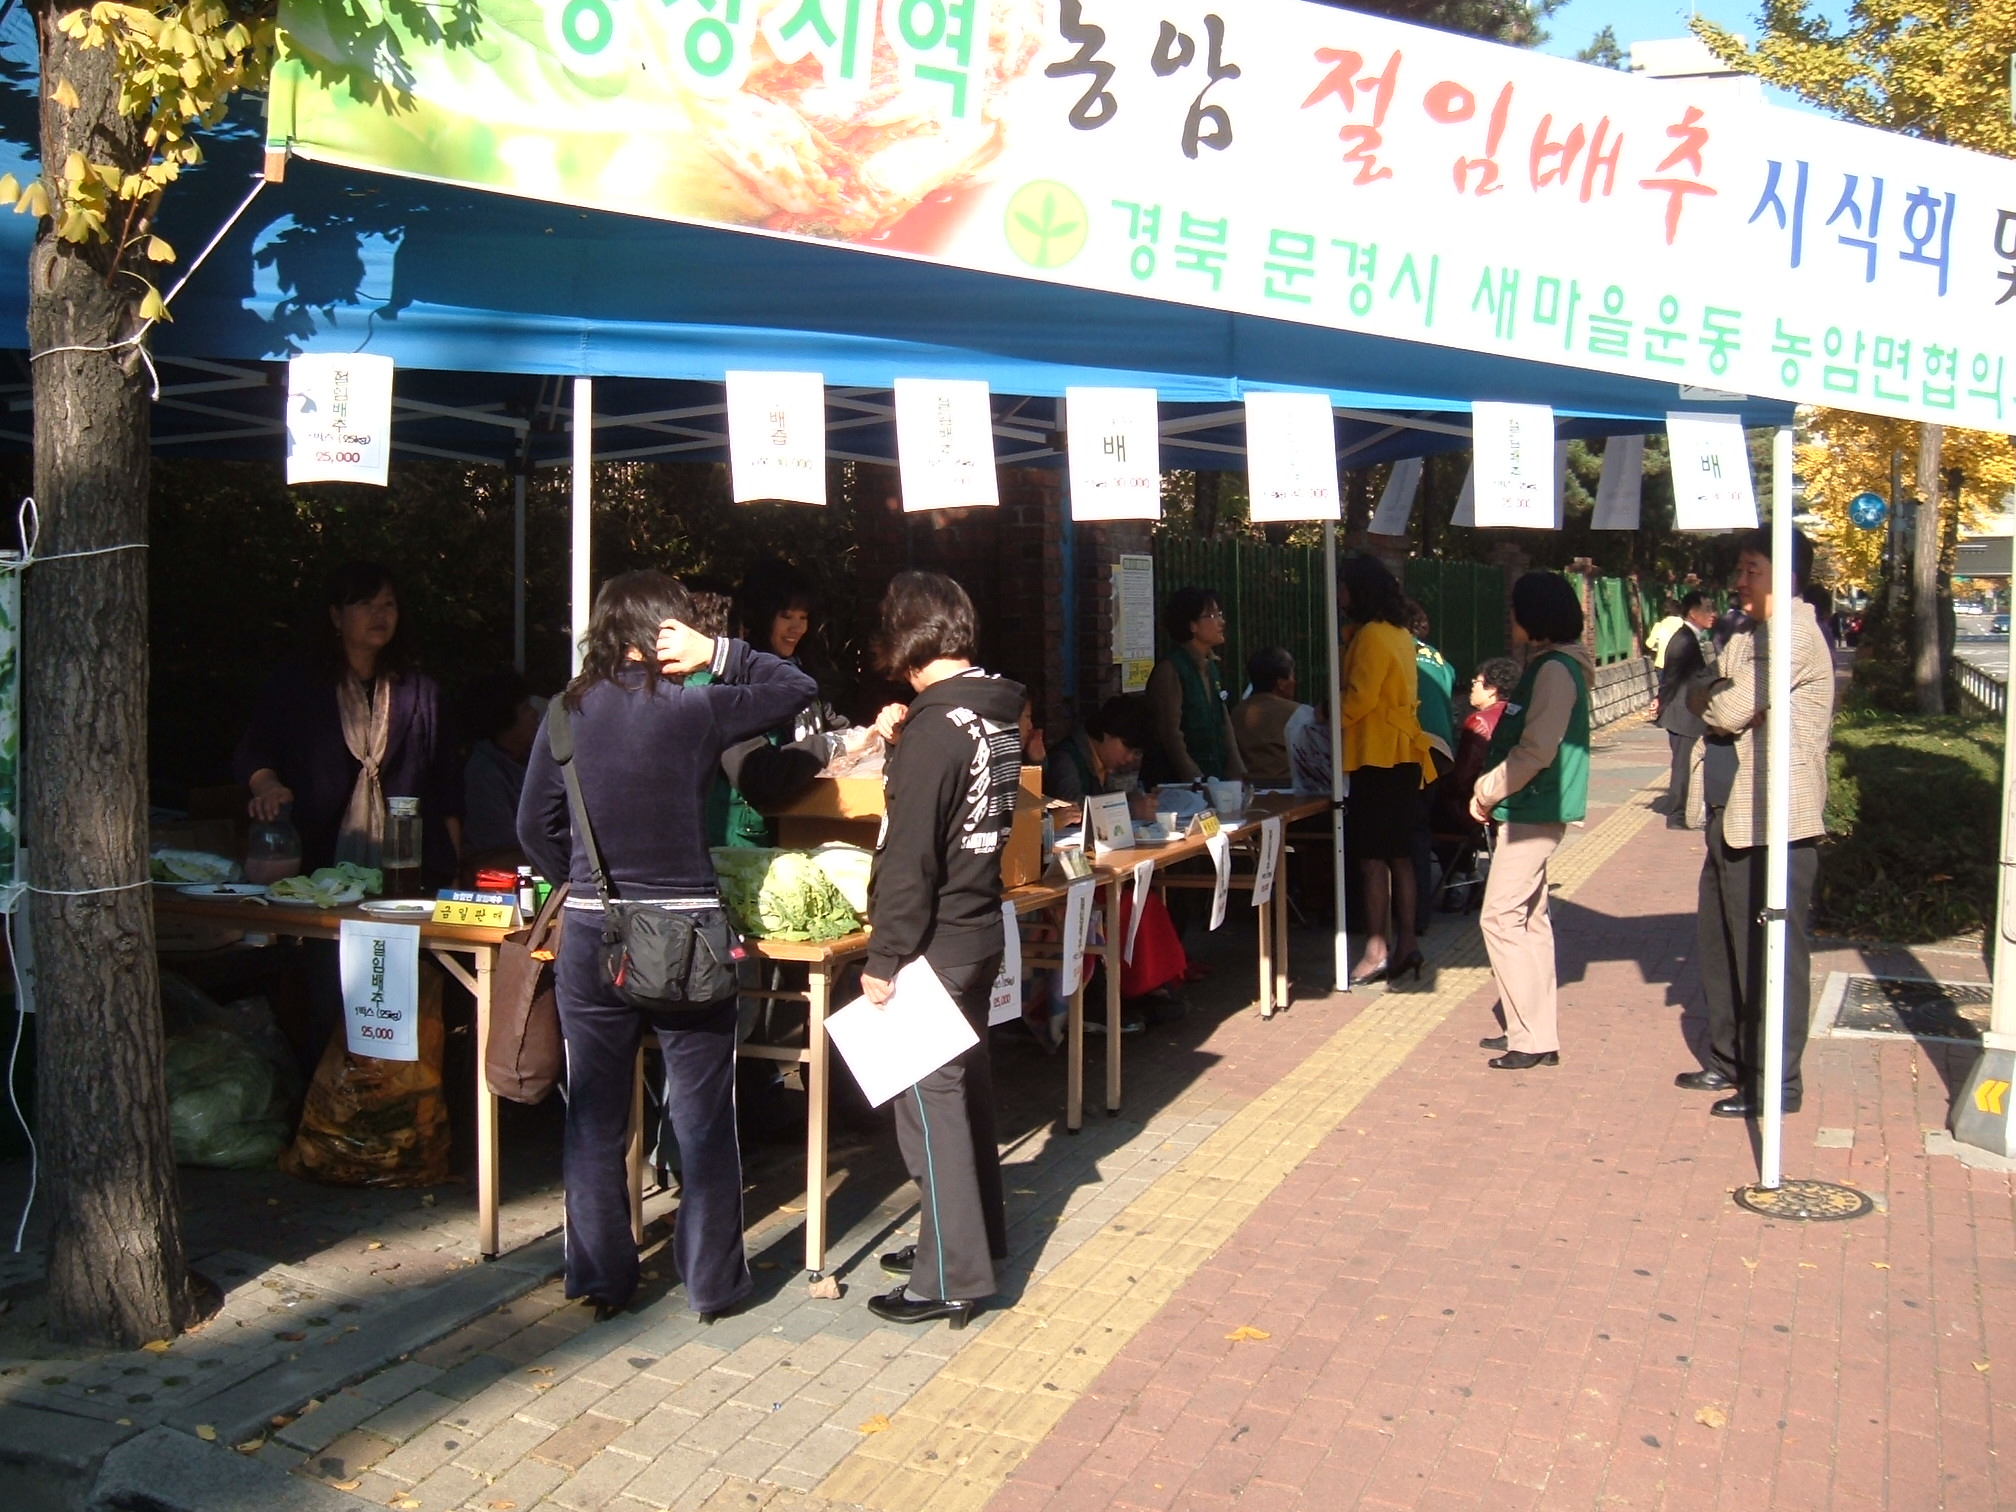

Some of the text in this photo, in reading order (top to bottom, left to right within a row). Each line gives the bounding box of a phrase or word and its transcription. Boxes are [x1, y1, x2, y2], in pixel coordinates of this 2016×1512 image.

[1044, 0, 1241, 159] 농암
[1301, 47, 1718, 244] 절임배추
[1748, 159, 1956, 297] 시식회
[1111, 199, 2016, 421] 경북 문경시 새마을운동 농암면협의
[315, 451, 361, 464] 25,000
[1103, 435, 1126, 463] 배
[371, 939, 386, 1008] 절임배추
[361, 1025, 394, 1040] 25,000
